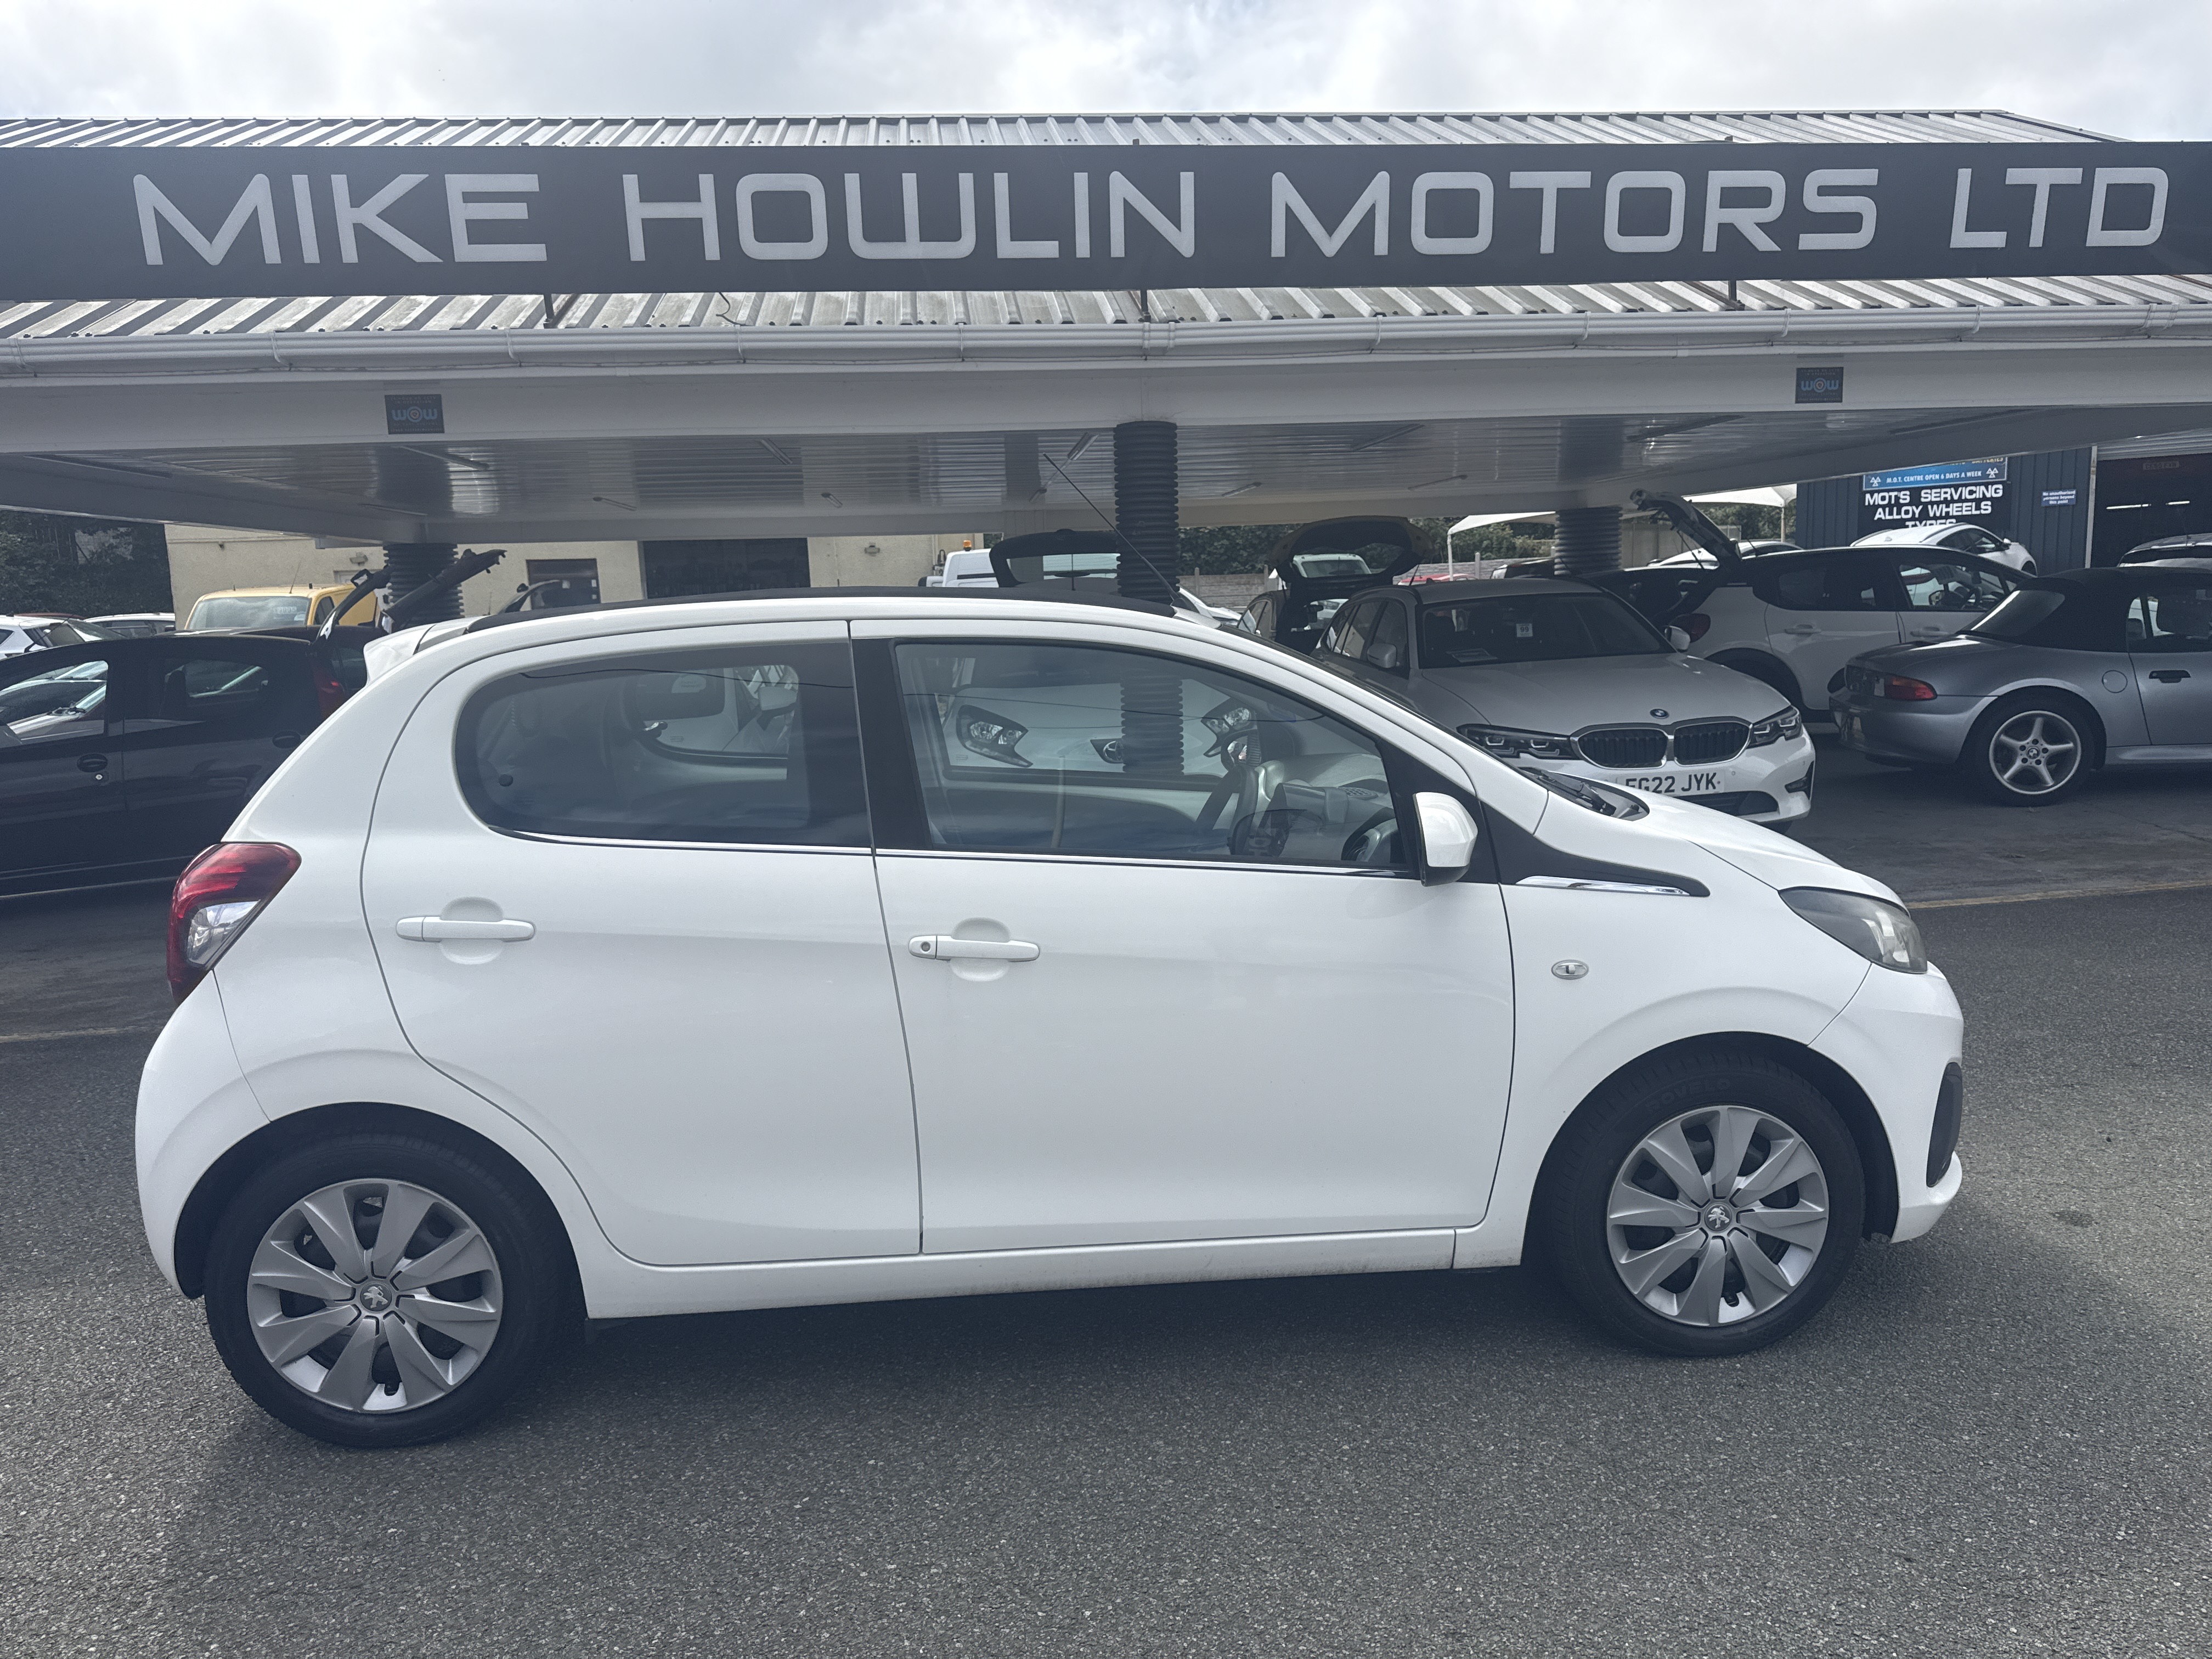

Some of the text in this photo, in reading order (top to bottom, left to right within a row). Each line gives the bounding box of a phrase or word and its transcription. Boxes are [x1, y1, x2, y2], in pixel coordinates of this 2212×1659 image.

[133, 167, 2169, 266] MIKE HOWLIN MOTORS LTD
[1865, 484, 2003, 506] MOT'S SERVICING
[1874, 501, 1992, 521] ALLOY WHEELS
[1681, 772, 1717, 792] JYK
